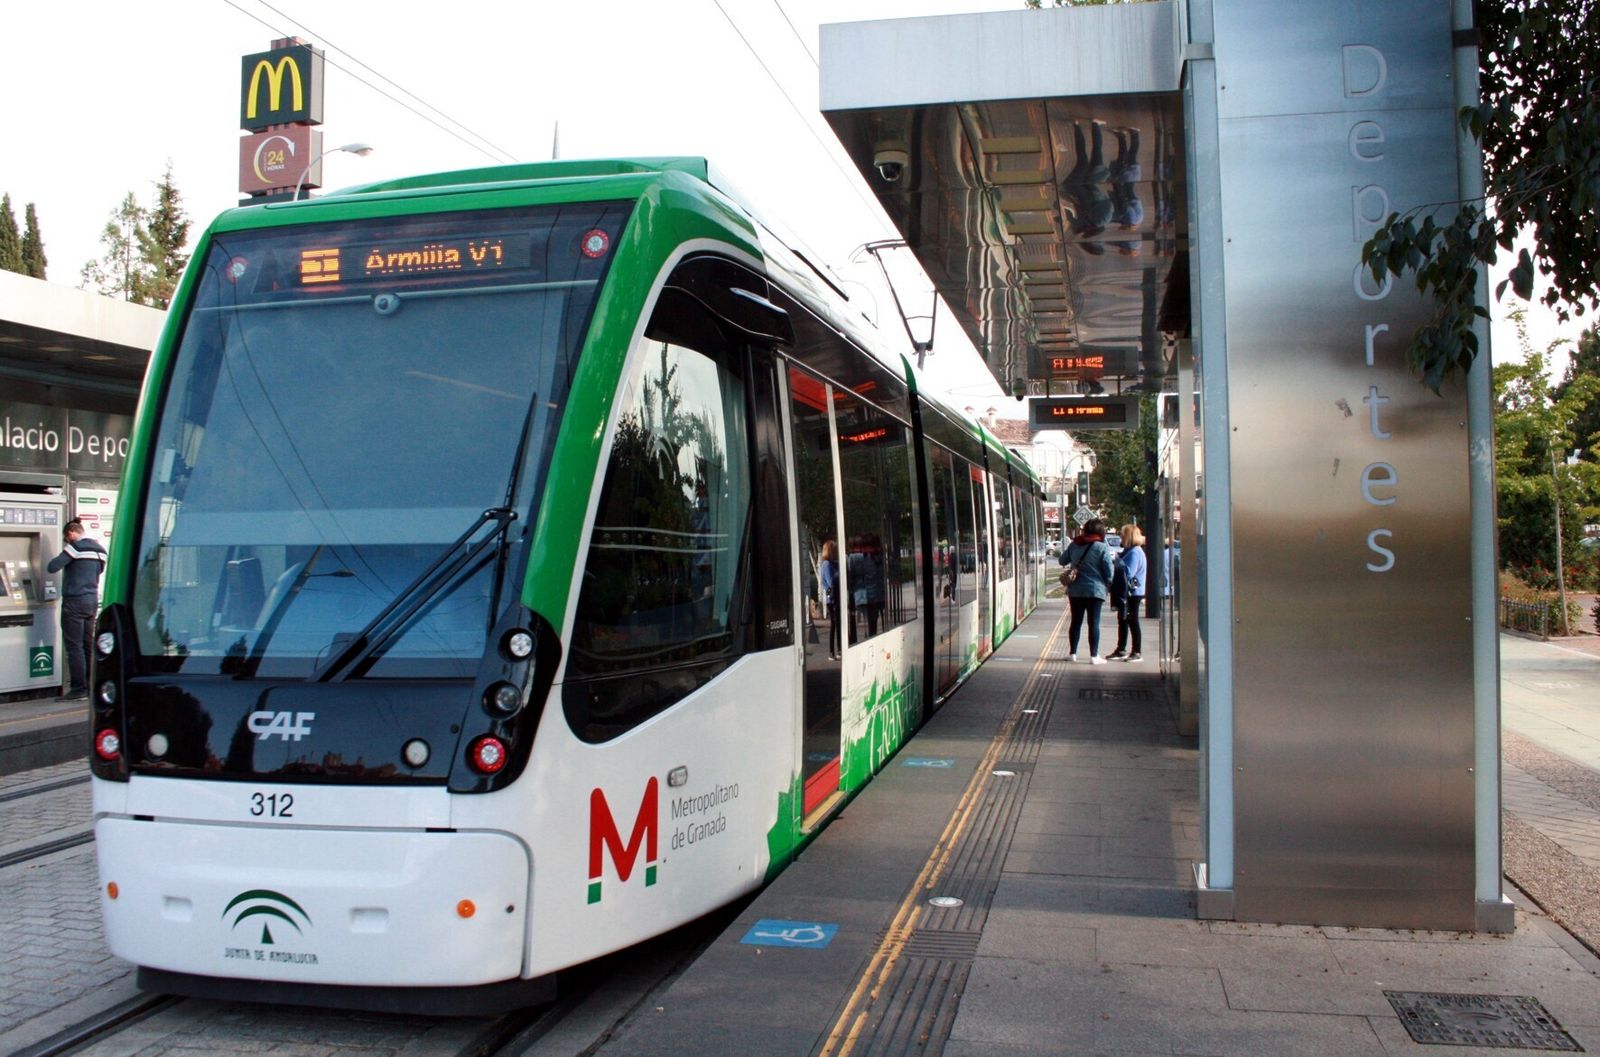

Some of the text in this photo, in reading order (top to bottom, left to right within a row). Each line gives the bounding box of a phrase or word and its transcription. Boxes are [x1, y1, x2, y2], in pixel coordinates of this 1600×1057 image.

[267, 150, 284, 165] 24
[1342, 44, 1399, 572] Deportes
[0, 417, 59, 452] lacio
[247, 711, 315, 741] CAF
[250, 792, 294, 818] 312
[671, 783, 739, 820] Metropolitano
[671, 812, 727, 850] de Granada
